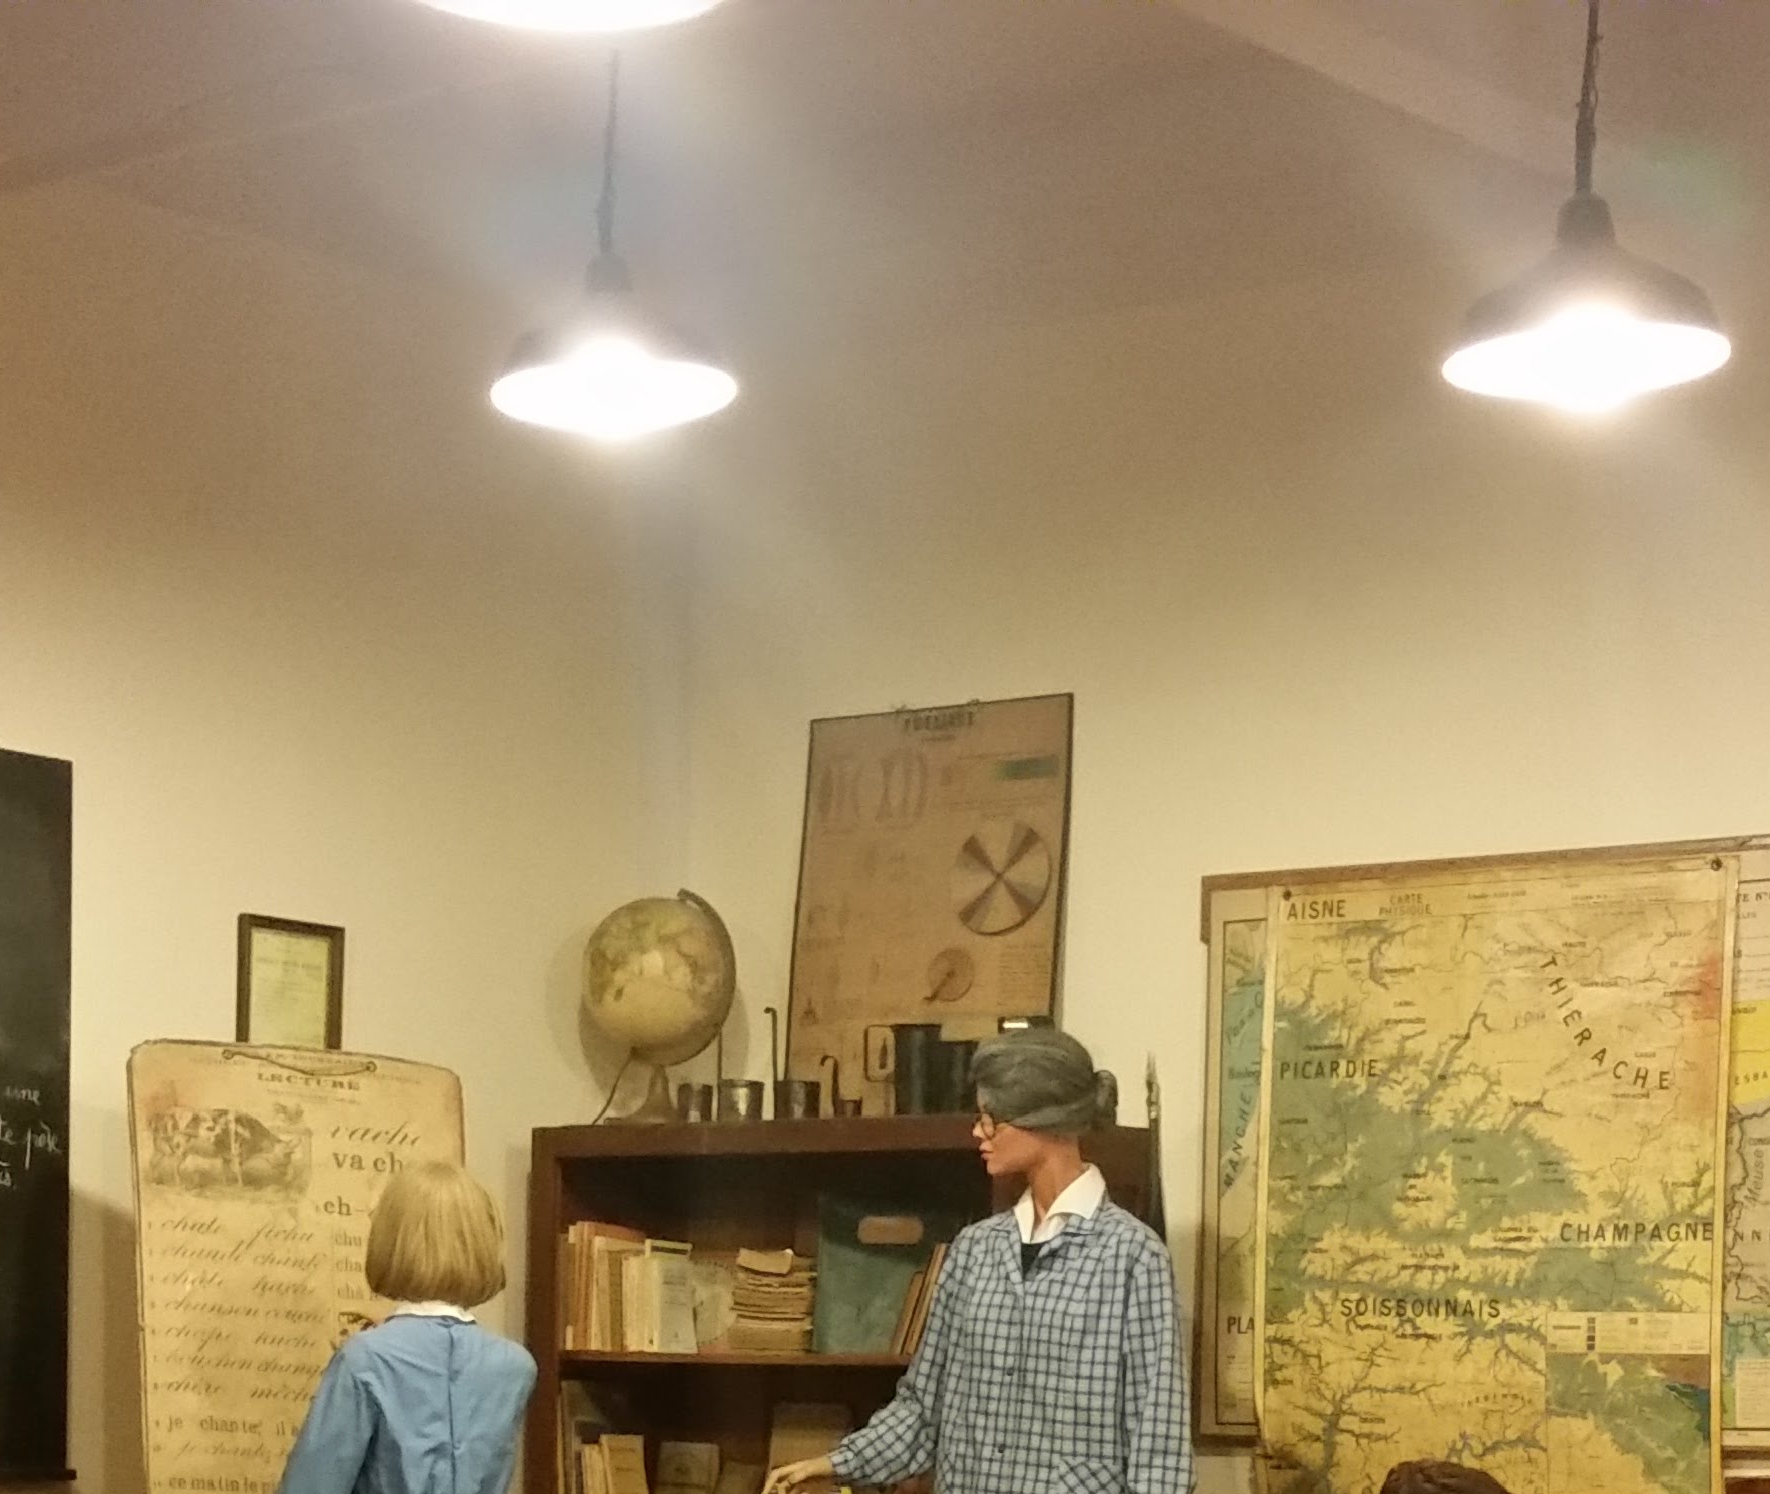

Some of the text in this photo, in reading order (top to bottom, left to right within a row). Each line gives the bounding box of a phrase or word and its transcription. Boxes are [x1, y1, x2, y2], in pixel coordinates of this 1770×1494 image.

[1286, 898, 1347, 921] AISNE
[1280, 1058, 1379, 1080] PICARDIE
[256, 1071, 361, 1092] LECTURE
[6, 1087, 42, 1107] une
[1223, 1089, 1252, 1188] MANCHE
[333, 1152, 366, 1171] va
[1559, 1221, 1714, 1243] CHAMPAGNE
[1340, 1297, 1501, 1319] SOISSONNAIS
